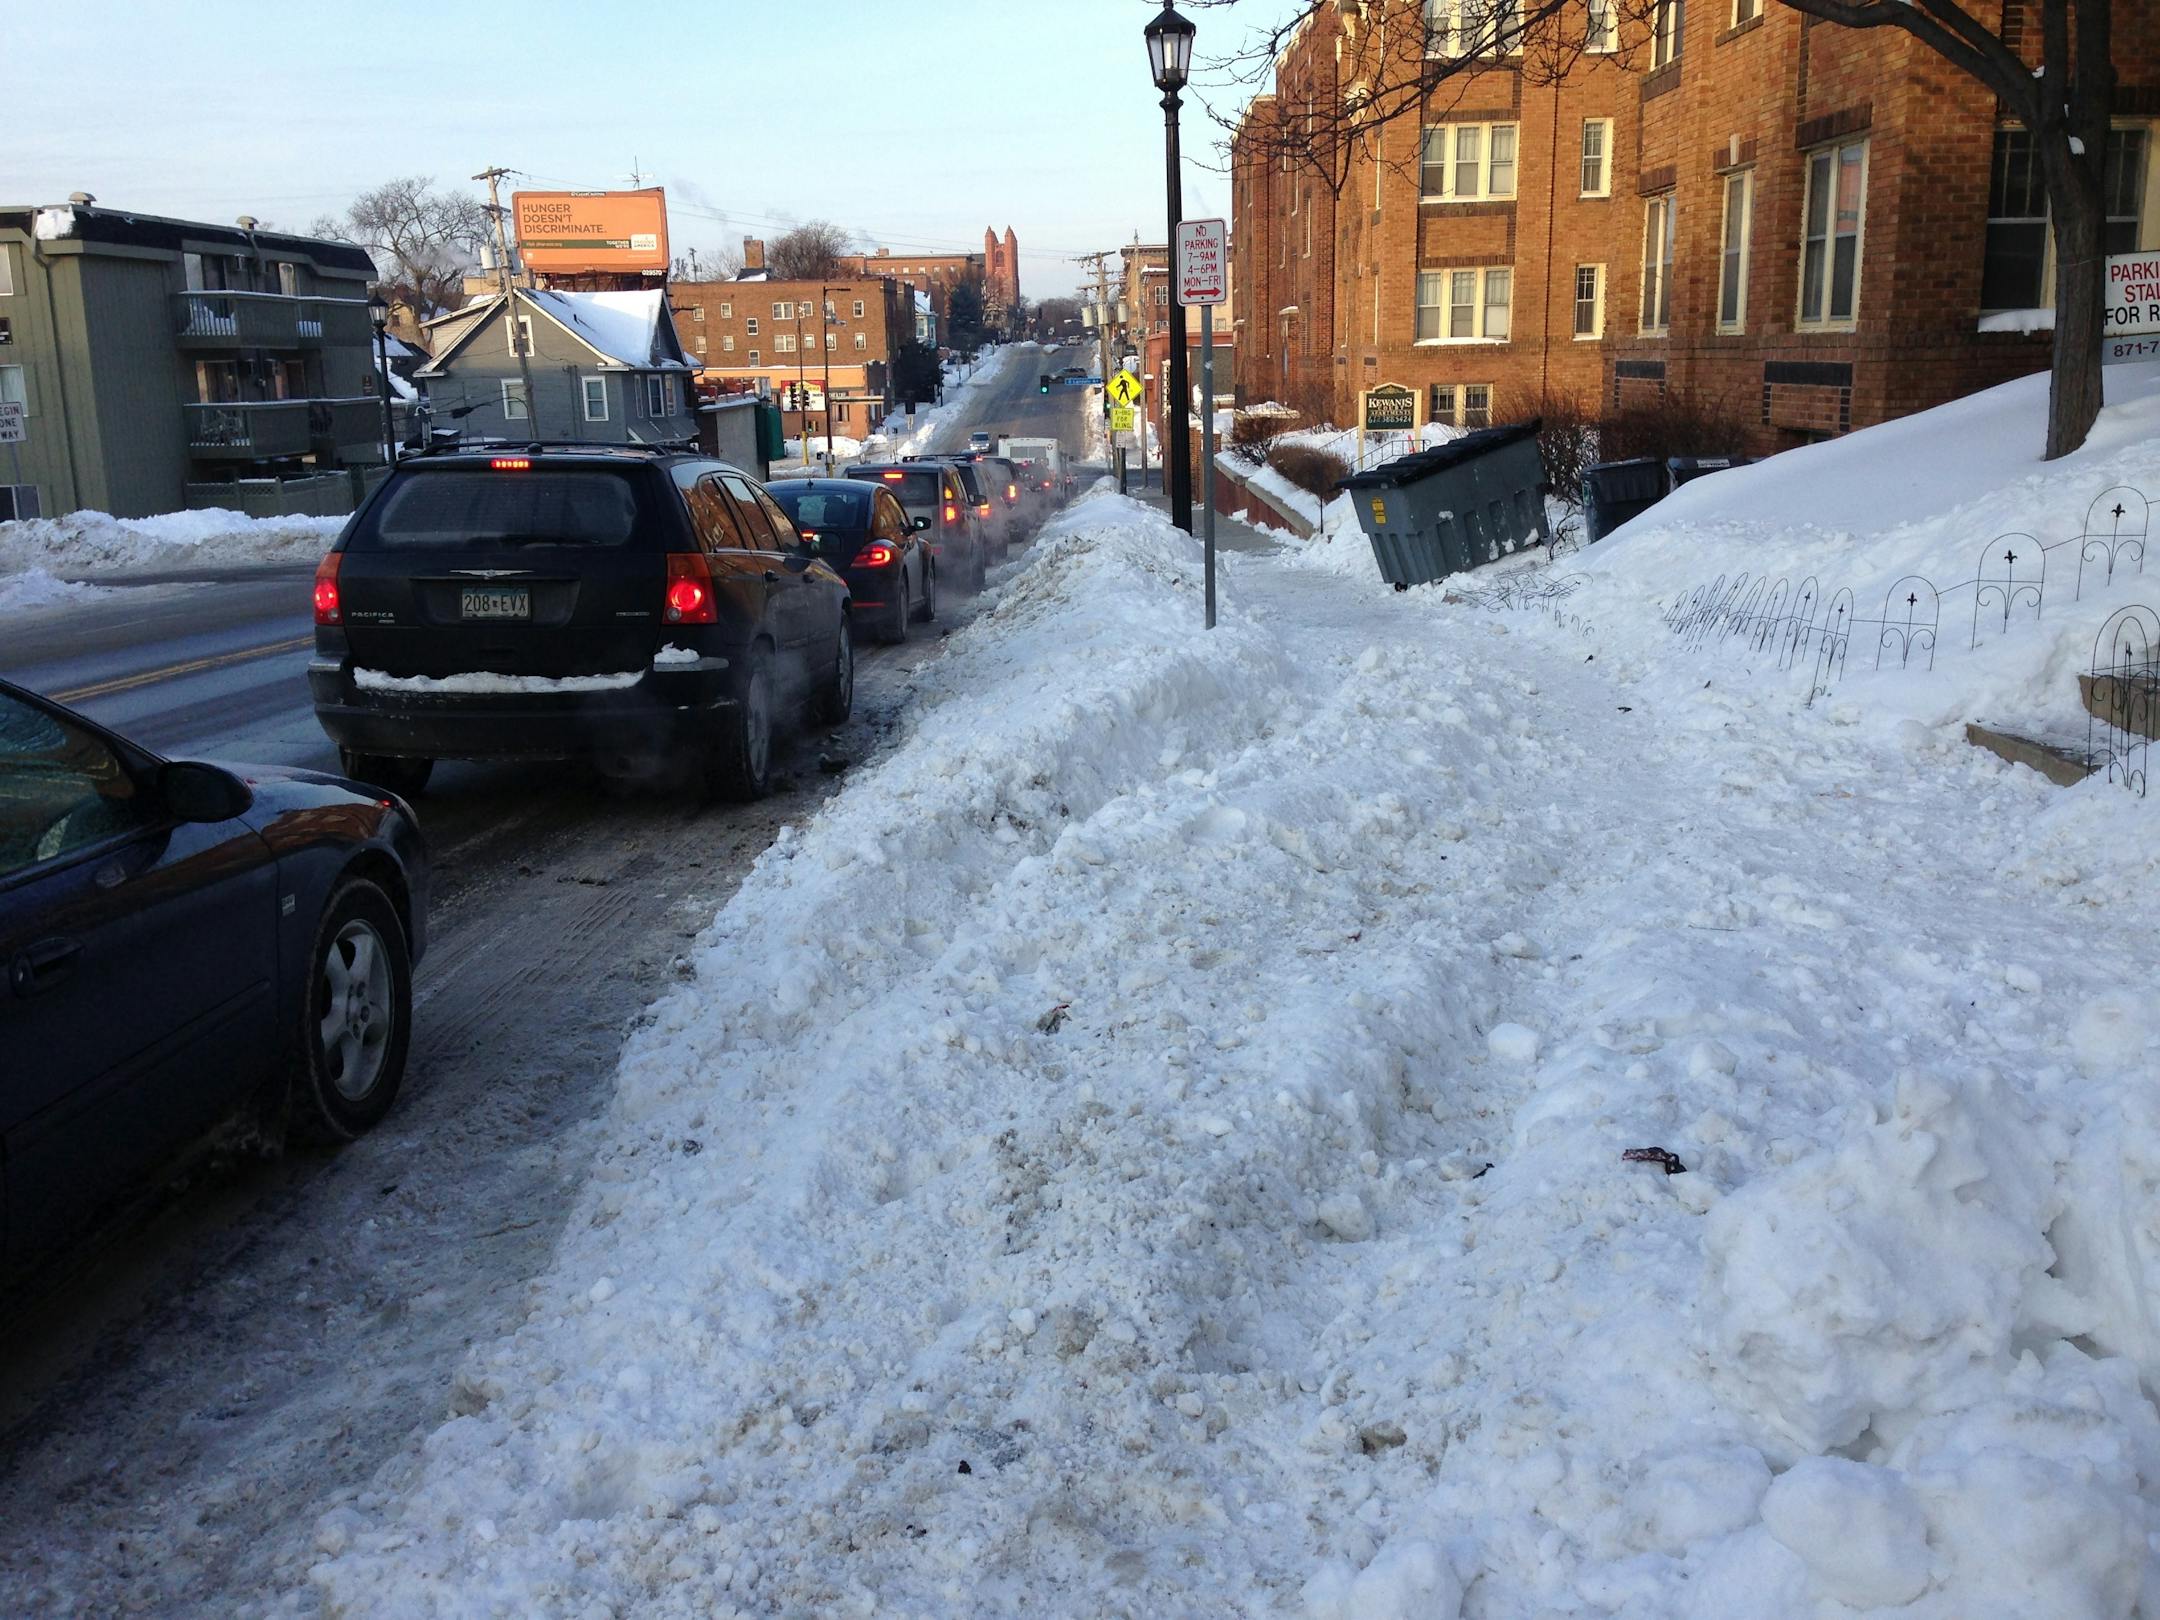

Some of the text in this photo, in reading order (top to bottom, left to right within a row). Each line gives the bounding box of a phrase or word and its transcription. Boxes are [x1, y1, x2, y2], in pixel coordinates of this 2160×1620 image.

[522, 203, 571, 213] HUNGER
[523, 213, 573, 223] DOESN'T
[524, 224, 607, 234] DISCRIMINATE.
[1195, 226, 1207, 237] NO
[1185, 238, 1219, 250] PARKING
[1187, 251, 1217, 262] 7-9AM
[1187, 263, 1217, 275] 4-6PM
[1184, 275, 1221, 287] MON-FRI
[2104, 306, 2140, 326] FOR
[1, 430, 19, 440] WAY
[464, 594, 526, 612] 208 EVX
